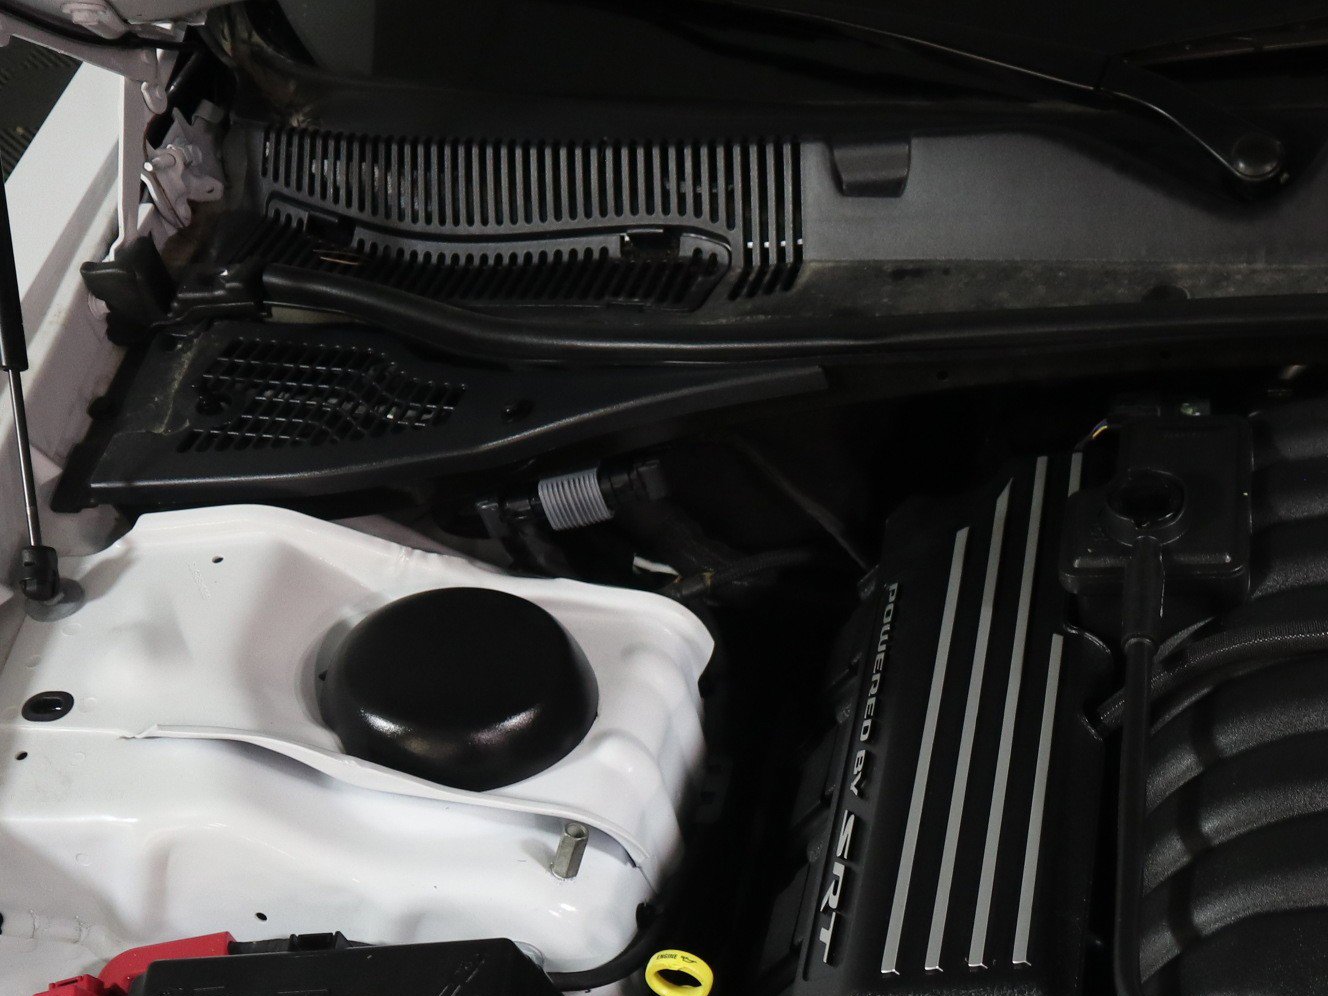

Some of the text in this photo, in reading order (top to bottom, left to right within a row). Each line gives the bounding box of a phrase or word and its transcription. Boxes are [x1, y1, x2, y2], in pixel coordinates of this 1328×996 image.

[820, 583, 898, 964] POWERED BY SRT
